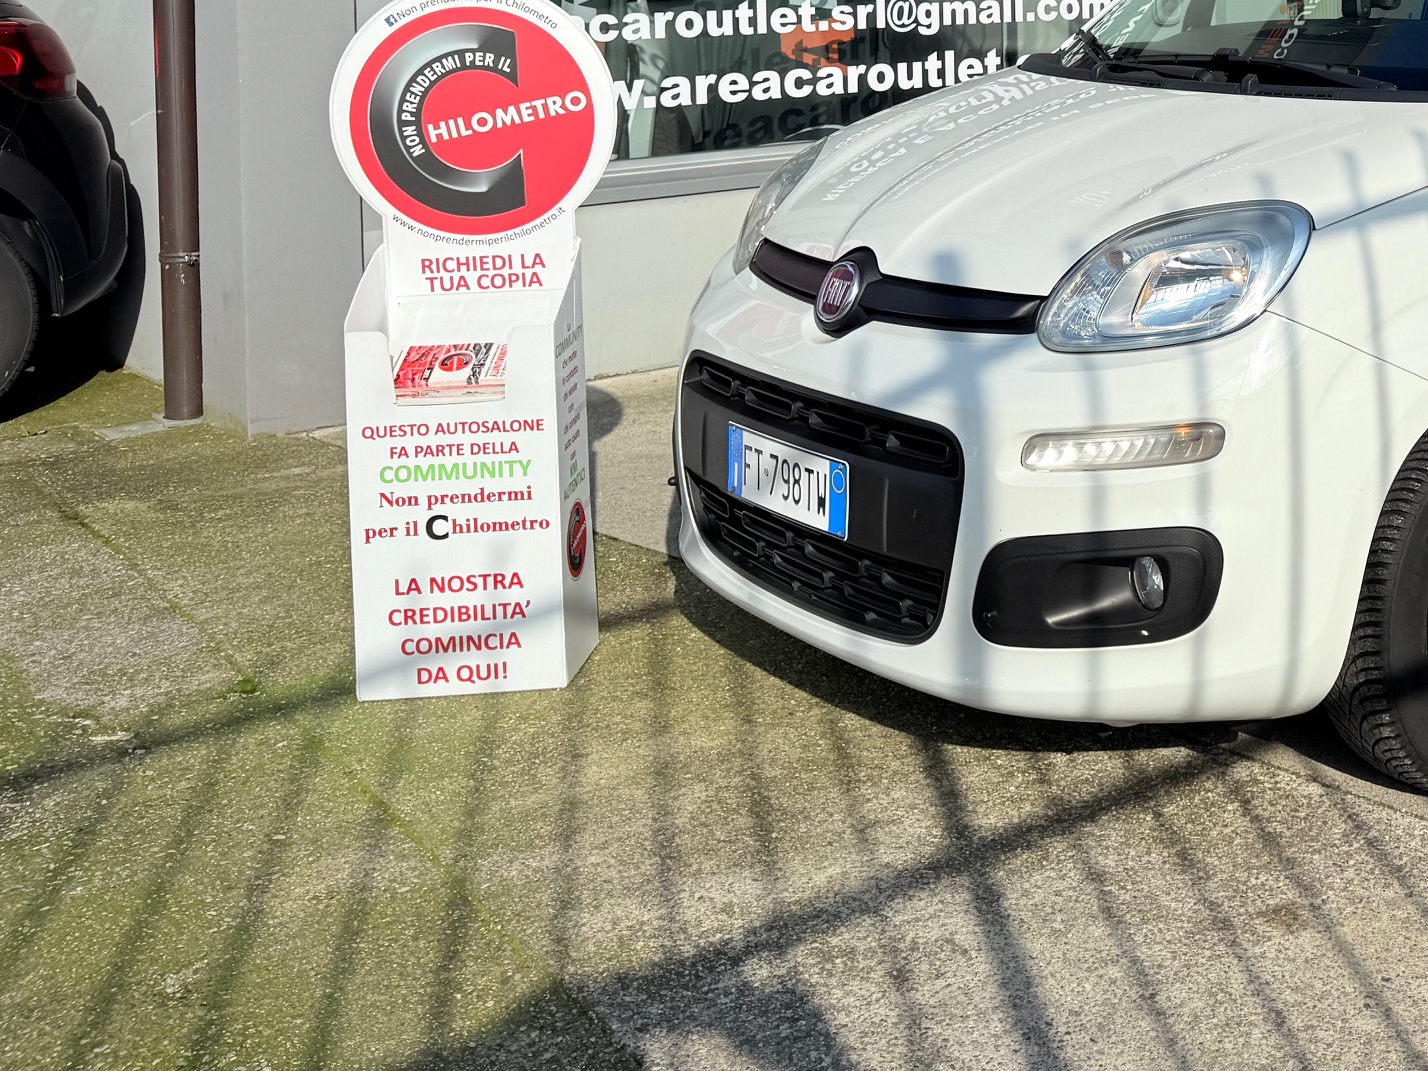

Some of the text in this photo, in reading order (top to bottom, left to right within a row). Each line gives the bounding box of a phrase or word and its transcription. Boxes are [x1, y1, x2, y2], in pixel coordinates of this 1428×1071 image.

[395, 2, 418, 20] Non
[402, 52, 512, 158] NON PRENDERMI PER IL
[427, 90, 588, 144] HILOMETRO
[392, 206, 566, 246] www.nonprendermiperilchilometro.it
[420, 252, 546, 275] RICHIEDI LA
[425, 272, 543, 293] TUA COPIA
[361, 419, 545, 441] QUESTO AUTOSALONE
[389, 440, 520, 459] FA PARTE DELLA
[379, 458, 532, 484] COMMUNITY
[378, 485, 533, 510] Non prendermi
[363, 524, 398, 544] per
[404, 521, 419, 537] il
[425, 514, 551, 541] Chilometro
[393, 572, 524, 596] LA NOSTRA
[400, 632, 522, 657] COMINCIA
[416, 661, 508, 685] DA QUI!
